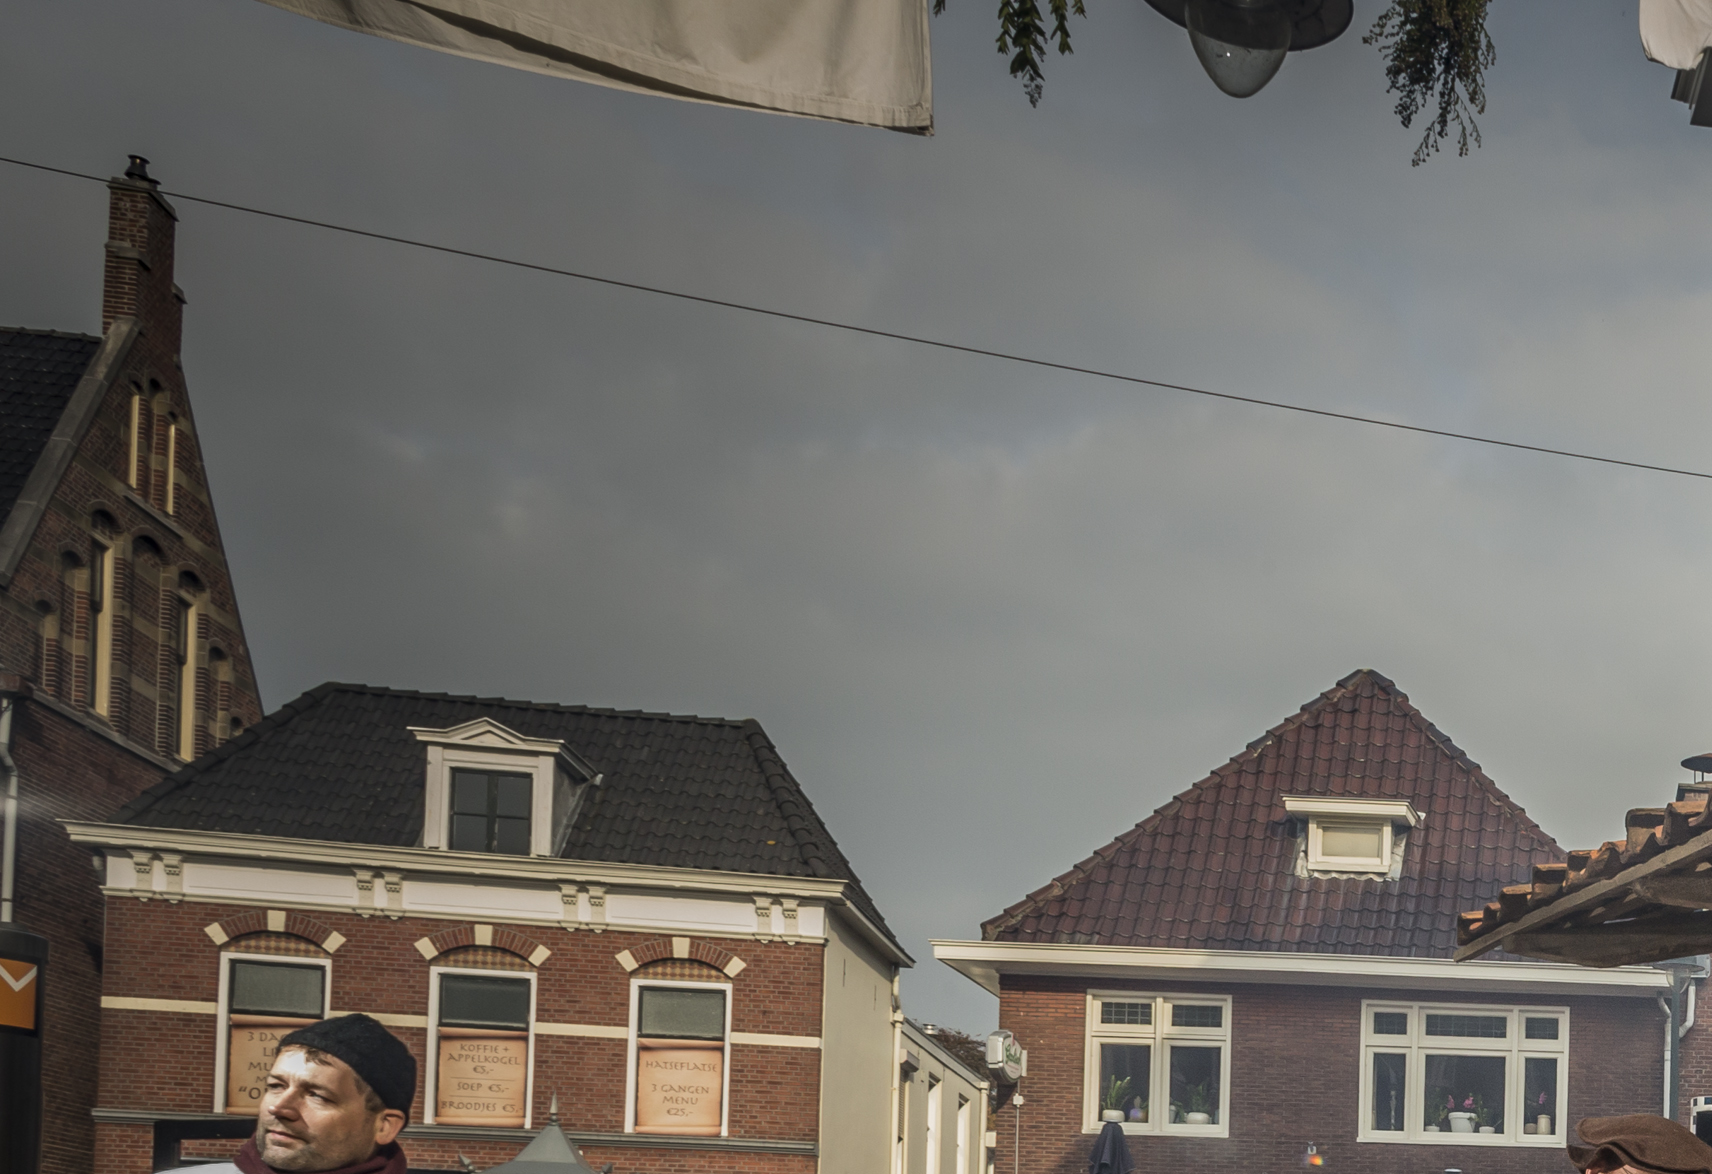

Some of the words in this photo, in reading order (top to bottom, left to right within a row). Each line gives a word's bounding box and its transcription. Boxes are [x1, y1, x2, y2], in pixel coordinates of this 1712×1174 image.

[247, 1031, 255, 1042] 3
[460, 1043, 500, 1054] KOFFIE
[447, 1053, 521, 1066] APPELKOGEL
[473, 1065, 494, 1075] €5,-
[645, 1060, 718, 1072] HATSEFLATSE
[456, 1081, 482, 1091] SOEP
[651, 1083, 657, 1092] 3
[661, 1084, 709, 1094] GANGEN
[662, 1095, 699, 1105] MENU
[441, 1100, 496, 1112] BROODJES
[666, 1107, 694, 1117] €25,-
